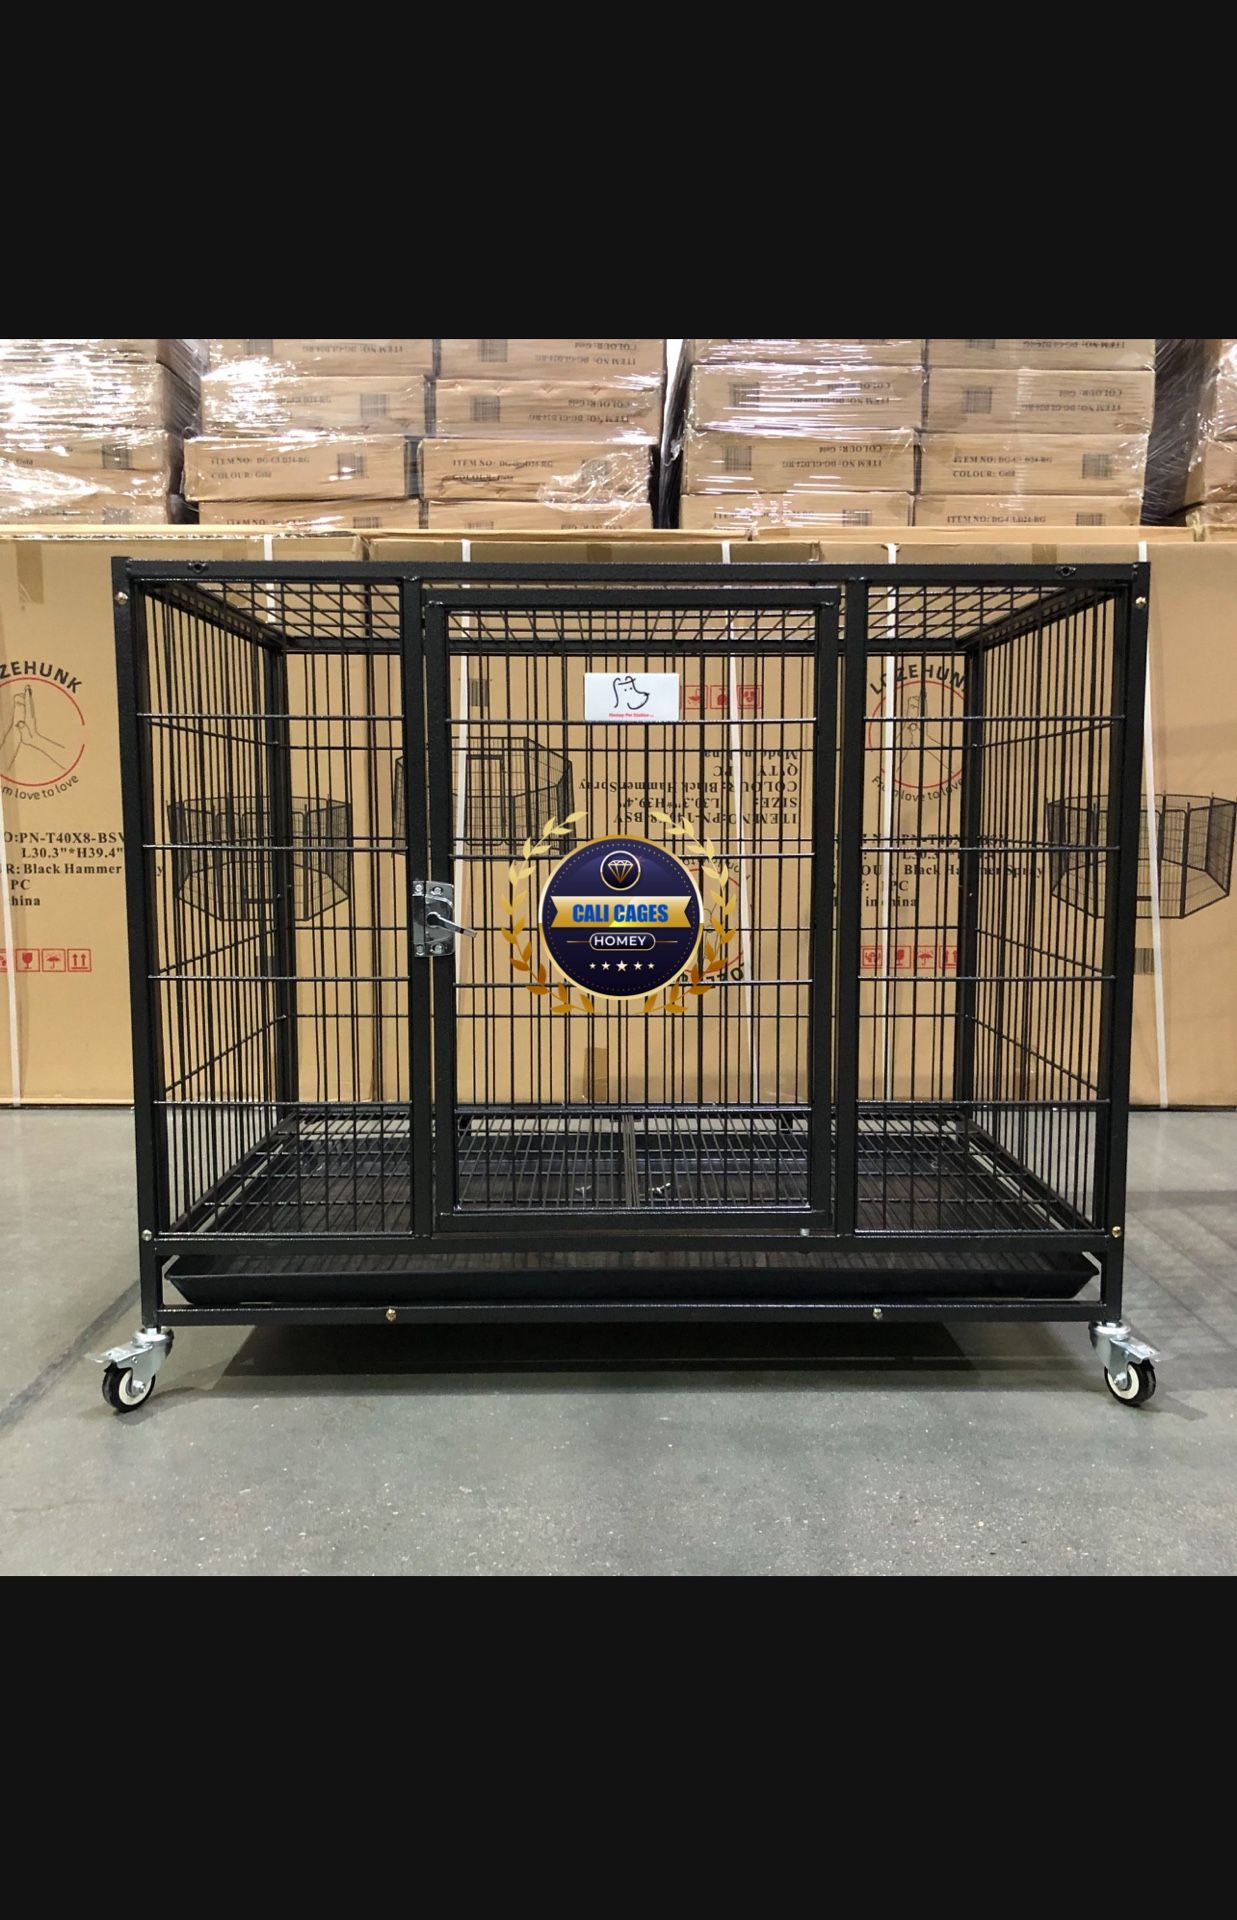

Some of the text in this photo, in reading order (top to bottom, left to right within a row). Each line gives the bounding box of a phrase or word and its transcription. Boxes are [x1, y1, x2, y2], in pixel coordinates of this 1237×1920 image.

[839, 445, 883, 453] COLOUR:
[953, 470, 996, 478] COLOUR:
[15, 788, 41, 801] love
[42, 788, 54, 799] to
[55, 774, 79, 793] love
[578, 778, 618, 793] Spry
[681, 781, 718, 793] Blck
[24, 863, 61, 874] Black
[64, 863, 122, 874] Hammer
[11, 896, 41, 906] hina
